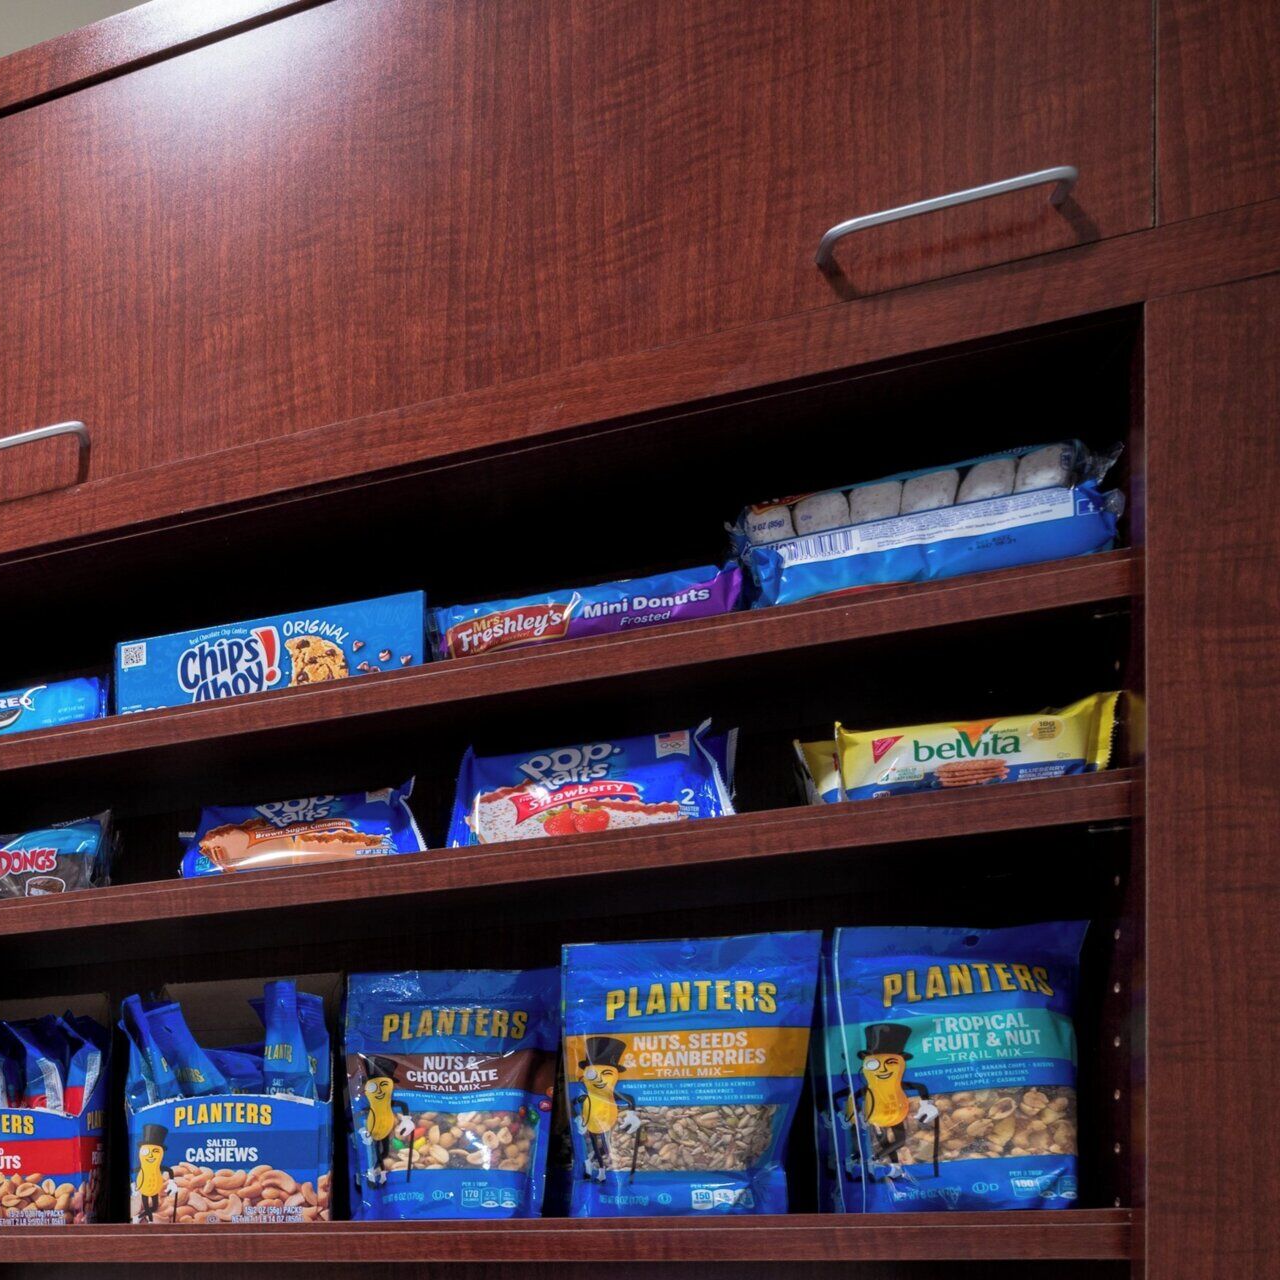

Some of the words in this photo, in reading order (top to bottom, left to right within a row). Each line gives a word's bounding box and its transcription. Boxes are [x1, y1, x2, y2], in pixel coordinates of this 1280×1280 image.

[584, 599, 629, 620] Mini
[632, 586, 711, 612] Donuts
[473, 615, 504, 633] Mrs.
[620, 609, 671, 627] Frosted
[283, 620, 349, 644] ORIGINAL
[458, 609, 564, 651] Freshley's
[181, 638, 259, 689] Chips
[912, 731, 1022, 763] belVita
[1019, 764, 1066, 777] BLUEBERRY
[528, 780, 625, 812] Strawberry
[255, 828, 283, 841] Brown
[284, 825, 308, 837] Sugar
[310, 819, 347, 833] Cinnamon
[882, 962, 1055, 1008] PLANTERS
[605, 979, 779, 1022] PLANTERS
[381, 1007, 529, 1042] PLANTERS
[932, 1012, 1030, 1034] TROPICAL
[634, 1034, 688, 1053] NUTS,
[688, 1031, 748, 1050] SEEDS
[922, 1033, 980, 1054] FRUIT
[986, 1034, 1001, 1048] &
[1005, 1029, 1041, 1046] NUT
[624, 1052, 637, 1069] &
[638, 1048, 766, 1068] CRANBERRIES
[406, 1065, 499, 1084] CHOCOLATE
[655, 1067, 699, 1078] TRAIL
[701, 1066, 723, 1077] MIX
[174, 1101, 272, 1128] PLANTERS
[206, 1138, 237, 1148] SALTED
[185, 1147, 258, 1163] CASHEWS
